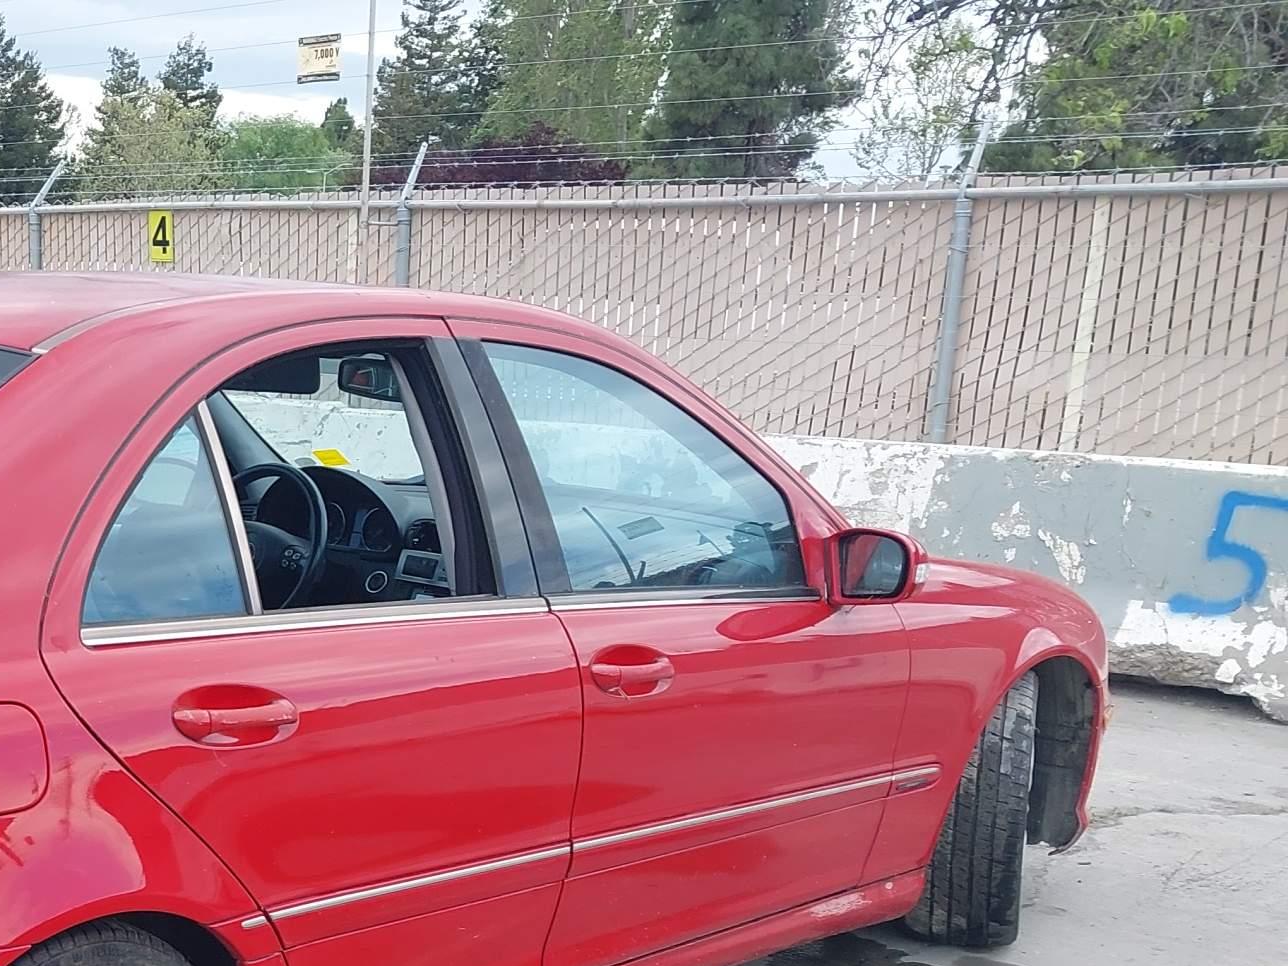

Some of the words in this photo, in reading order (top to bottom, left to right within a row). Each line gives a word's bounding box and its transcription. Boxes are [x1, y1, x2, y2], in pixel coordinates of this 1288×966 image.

[314, 48, 334, 60] 7,000
[152, 215, 170, 254] 4
[1168, 490, 1288, 614] 5
